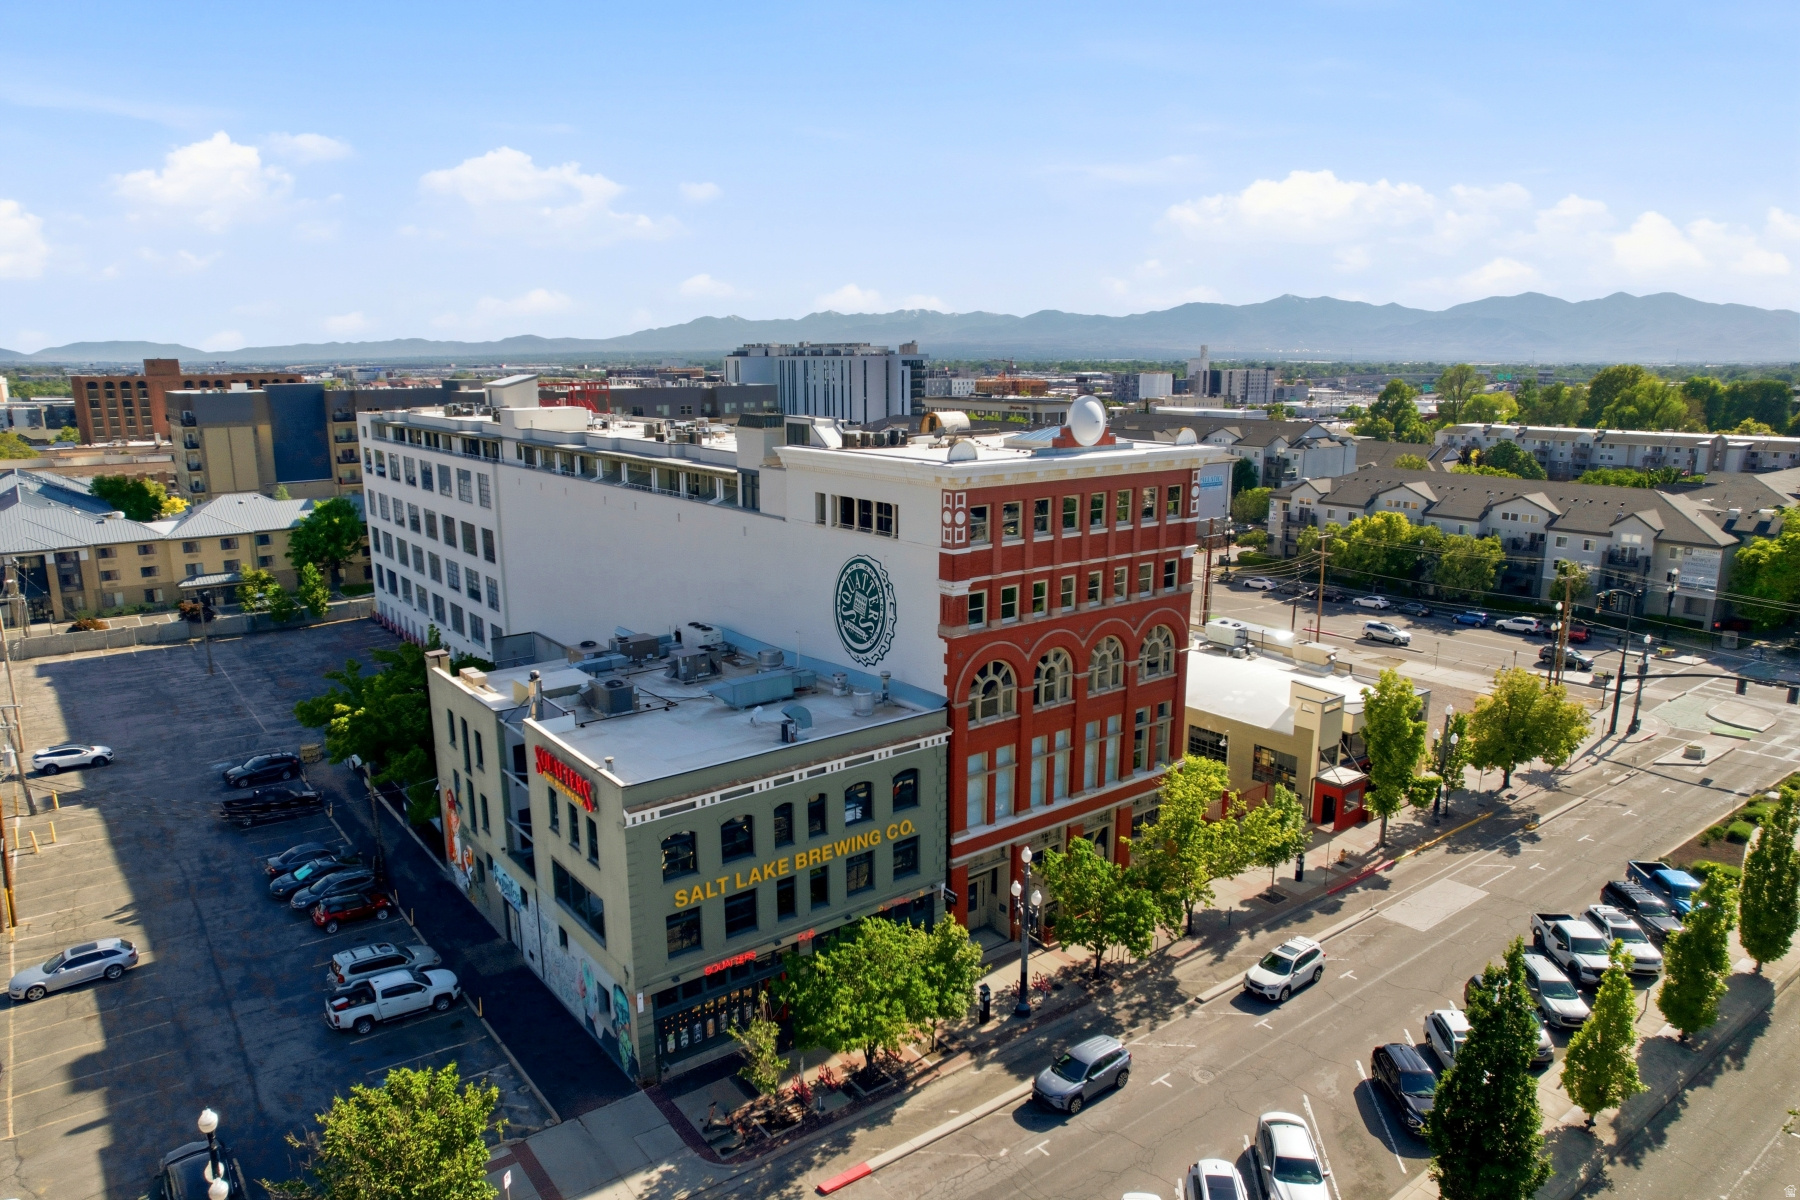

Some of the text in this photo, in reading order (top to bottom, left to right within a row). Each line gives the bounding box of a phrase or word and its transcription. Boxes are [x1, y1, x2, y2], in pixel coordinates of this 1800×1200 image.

[841, 572, 879, 637] SQUATTERS
[674, 819, 916, 908] SALT LAKE BREWING CO.
